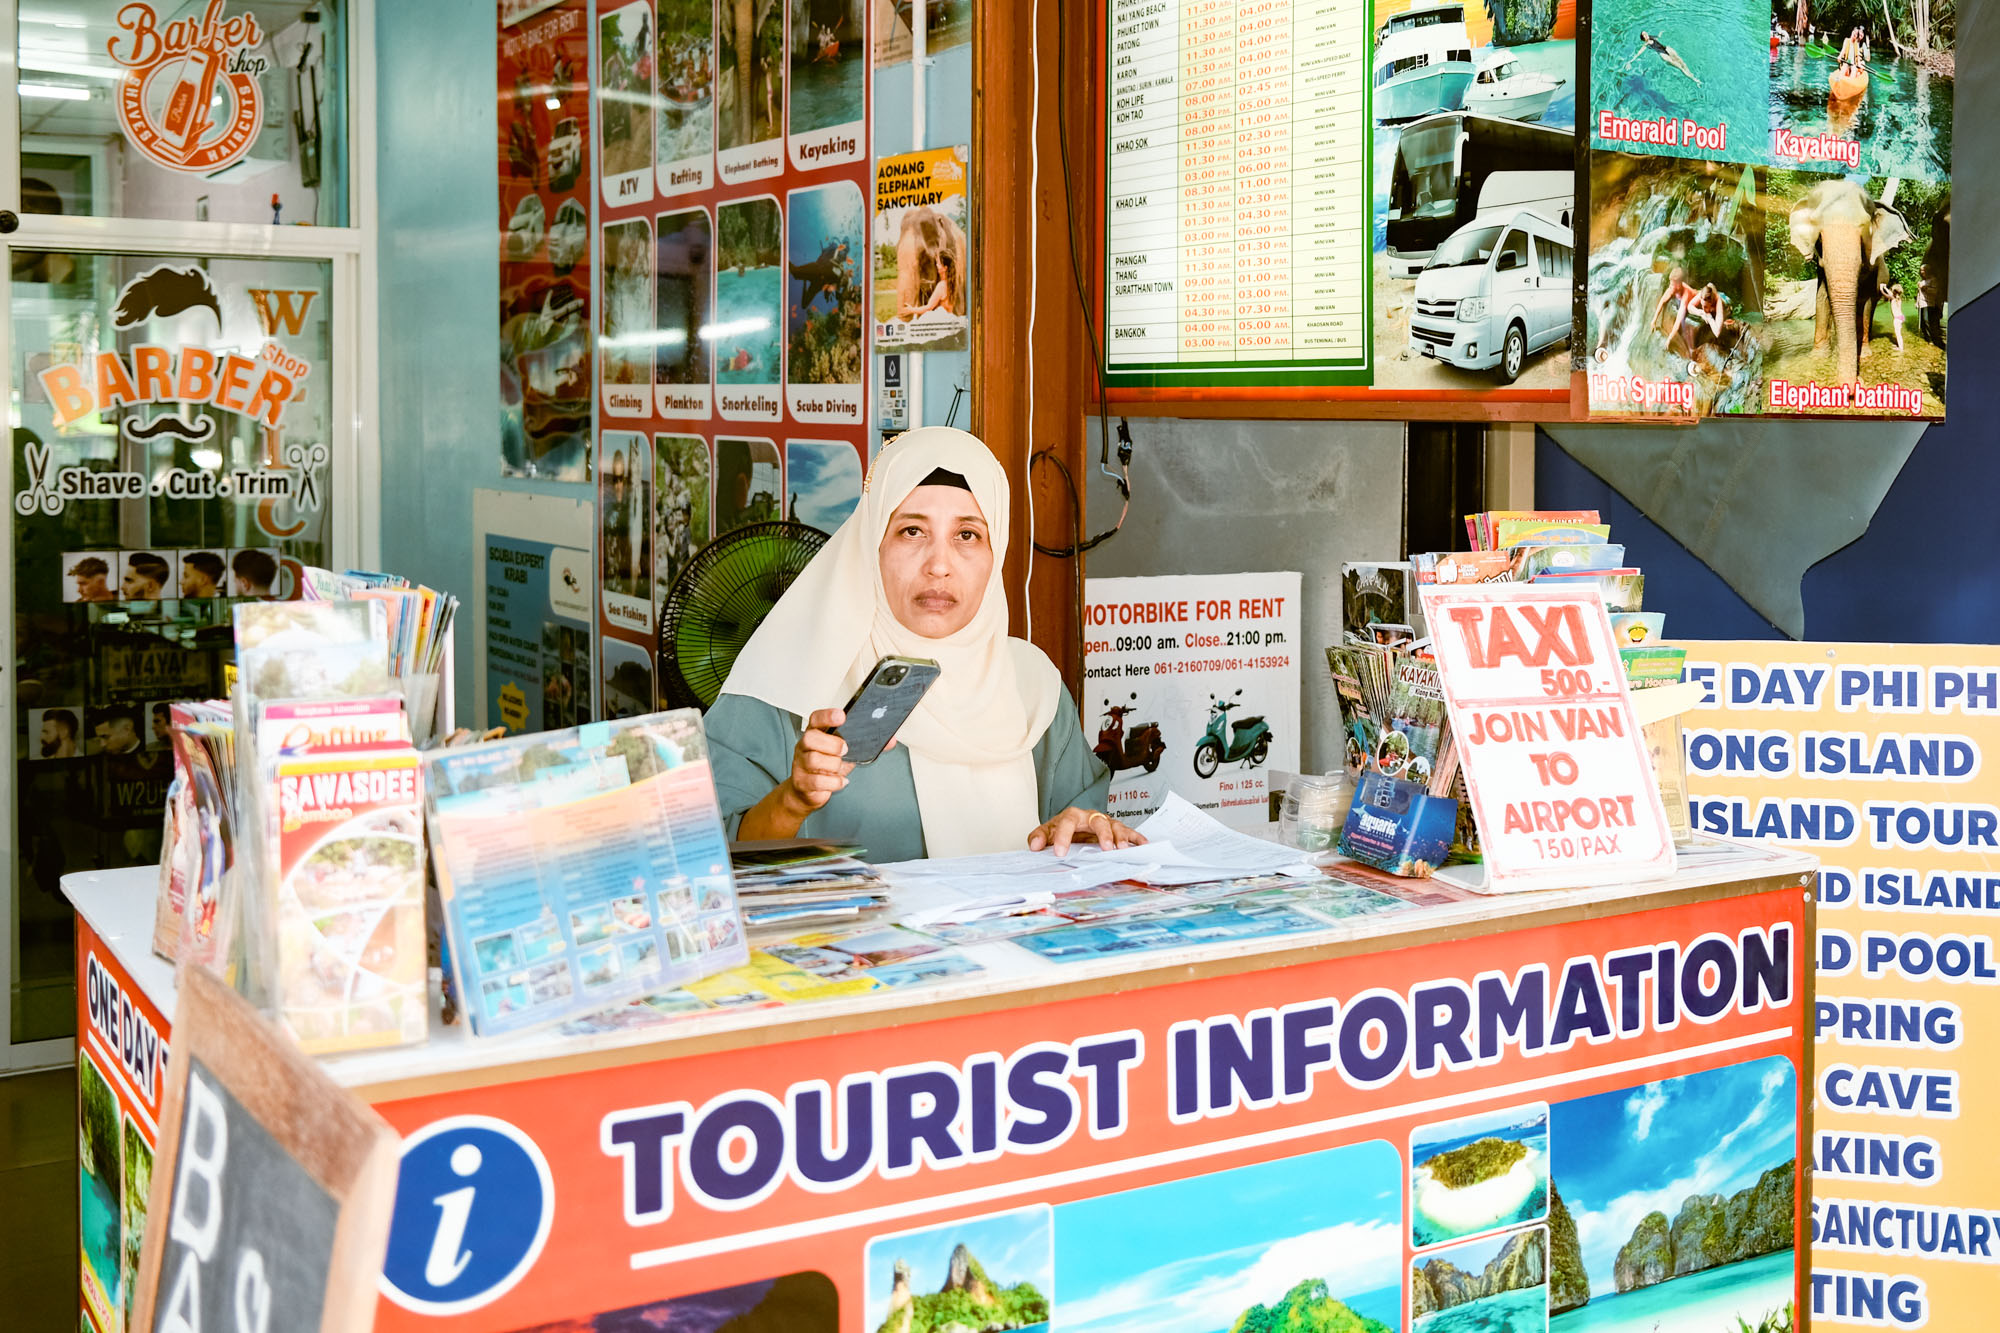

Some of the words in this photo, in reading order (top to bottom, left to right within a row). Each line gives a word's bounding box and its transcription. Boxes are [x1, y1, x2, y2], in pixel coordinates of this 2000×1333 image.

[1129, 8, 1145, 20] YANG
[1146, 2, 1166, 15] BEACH
[1239, 2, 1272, 17] 04.00
[1117, 24, 1140, 38] PHUKET
[1141, 19, 1159, 31] TOWN
[1187, 16, 1216, 31] 11.30
[107, 0, 262, 67] Barber
[1117, 38, 1141, 52] PATONG
[228, 48, 267, 76] shop
[1117, 55, 1131, 66] KATA
[1117, 68, 1137, 80] KARON
[1239, 66, 1272, 81] 01.00
[1185, 78, 1216, 92] 07.00
[1239, 81, 1271, 96] 02.45
[126, 76, 152, 142] SHAVES
[1117, 98, 1130, 109] KOH
[1131, 94, 1144, 106] LIPE
[1185, 94, 1216, 107] 08.00
[1239, 98, 1271, 111] 05.00
[207, 85, 253, 162] HAIRCUTS
[1116, 112, 1130, 123] KOH
[1131, 109, 1143, 121] TAO
[1185, 108, 1216, 121] 04.30
[1600, 111, 1678, 146] Emerald
[1682, 121, 1726, 151] Pool
[800, 137, 856, 161] Kayaking
[1116, 141, 1134, 152] KHAO
[1135, 138, 1148, 149] SOK
[1776, 130, 1861, 168] Kayaking
[724, 163, 752, 175] Elephant
[753, 157, 779, 169] Bathing
[878, 161, 925, 179] AONANG
[619, 177, 639, 197] ATV
[670, 169, 703, 187] Rafting
[878, 176, 931, 195] ELEPHANT
[1240, 177, 1271, 189] 11.00
[1184, 185, 1215, 197] 08.30
[877, 191, 943, 210] SANCTUARY
[1116, 198, 1133, 209] KHAO
[1134, 196, 1147, 206] LAK
[1115, 255, 1147, 266] PHANGAN
[1115, 270, 1137, 280] THANG
[1154, 282, 1173, 292] TOWN
[1184, 307, 1215, 317] 04.30
[1238, 304, 1271, 315] 07.30
[1115, 327, 1146, 338] BANGKOK
[1184, 323, 1215, 333] 04.00
[1238, 320, 1272, 330] 05.00
[1184, 338, 1215, 347] 03.00
[1239, 336, 1272, 346] 05.00
[42, 347, 293, 427] BARBER
[263, 344, 308, 379] Shop
[1593, 374, 1626, 402] Hot
[1630, 375, 1695, 411] Spring
[609, 395, 643, 413] Climbing
[664, 396, 704, 410] Plankton
[722, 395, 778, 416] Snorkeling
[1770, 380, 1850, 412] Elephant
[1852, 381, 1924, 416] bathing
[796, 399, 824, 413] Scuba
[826, 399, 857, 417] Diving
[63, 471, 141, 496] Shave
[169, 471, 212, 496] Cut
[235, 472, 290, 496] Trim
[515, 551, 545, 570] EXPERT
[608, 602, 621, 615] Sea
[622, 604, 648, 626] Fishing
[1085, 601, 1188, 626] MOTORBIKE
[1196, 599, 1231, 621] FOR
[1239, 597, 1285, 620] RENT
[1085, 635, 1152, 656] pen..09:00
[1157, 638, 1180, 650] am.
[1265, 631, 1287, 647] pm.
[1447, 604, 1595, 669] TAXI
[1125, 663, 1150, 677] Here
[1399, 665, 1441, 689] KAYAKI
[1732, 668, 1825, 705] DAY
[1841, 670, 1918, 707] PHI
[1935, 672, 1998, 709] PH
[1469, 711, 1547, 746] JOIN
[1552, 706, 1625, 742] VAN
[1684, 734, 1789, 773] ONG
[1805, 736, 1976, 777] ISLAND
[1529, 751, 1580, 787] TO
[281, 768, 415, 808] SAWASDEE
[1219, 782, 1234, 791] Fino
[1241, 780, 1253, 789] 125
[1124, 790, 1138, 800] 110
[1139, 790, 1150, 799] cc.
[1116, 809, 1143, 818] Distances
[1503, 795, 1638, 835] AIRPORT
[1689, 801, 1855, 841] ISLAND
[1869, 806, 2000, 847] TOUR
[1531, 835, 1622, 861] 150/PAX
[1865, 873, 2000, 909] ISLAND
[1867, 937, 1997, 978] POOL
[88, 957, 119, 1050] ONE
[123, 998, 156, 1097] DAY
[1815, 1001, 1956, 1045] PRING
[611, 1038, 1137, 1216] TOURIST
[1175, 928, 1791, 1116] INFORMATION
[1825, 1069, 1953, 1113] CAVE
[1814, 1135, 1935, 1181] KING
[1811, 1273, 1921, 1323] TING
